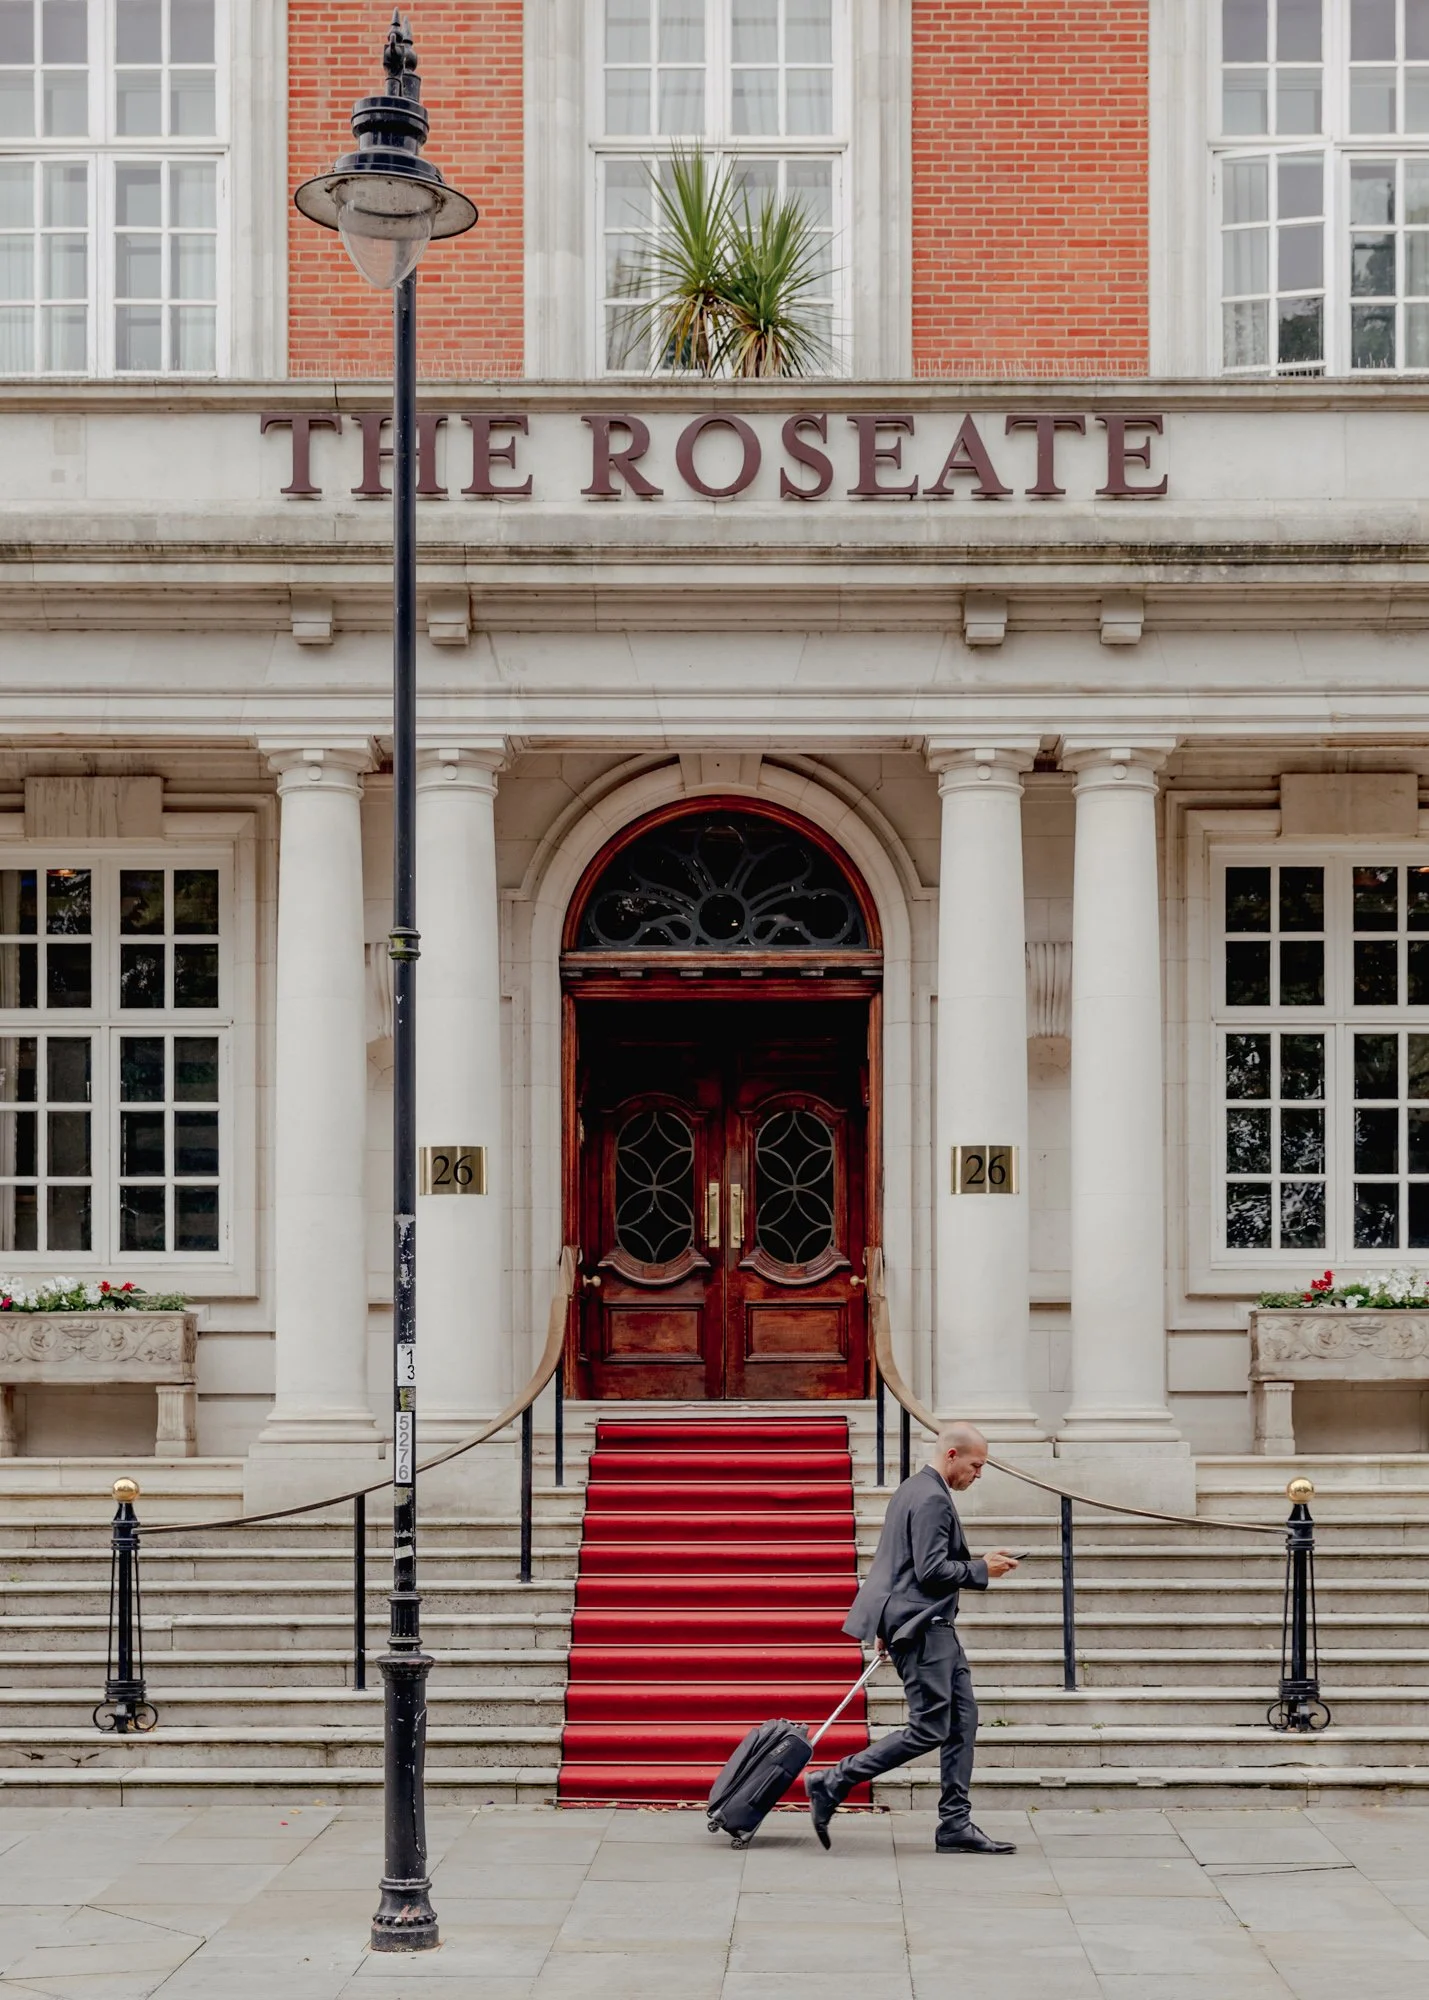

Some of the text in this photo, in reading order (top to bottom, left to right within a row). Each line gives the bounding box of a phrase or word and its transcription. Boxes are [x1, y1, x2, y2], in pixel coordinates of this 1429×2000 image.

[260, 413, 1168, 498] THE ROSEATE
[432, 1154, 473, 1186] 26
[965, 1154, 1006, 1185] 26
[399, 1415, 409, 1480] 5276
